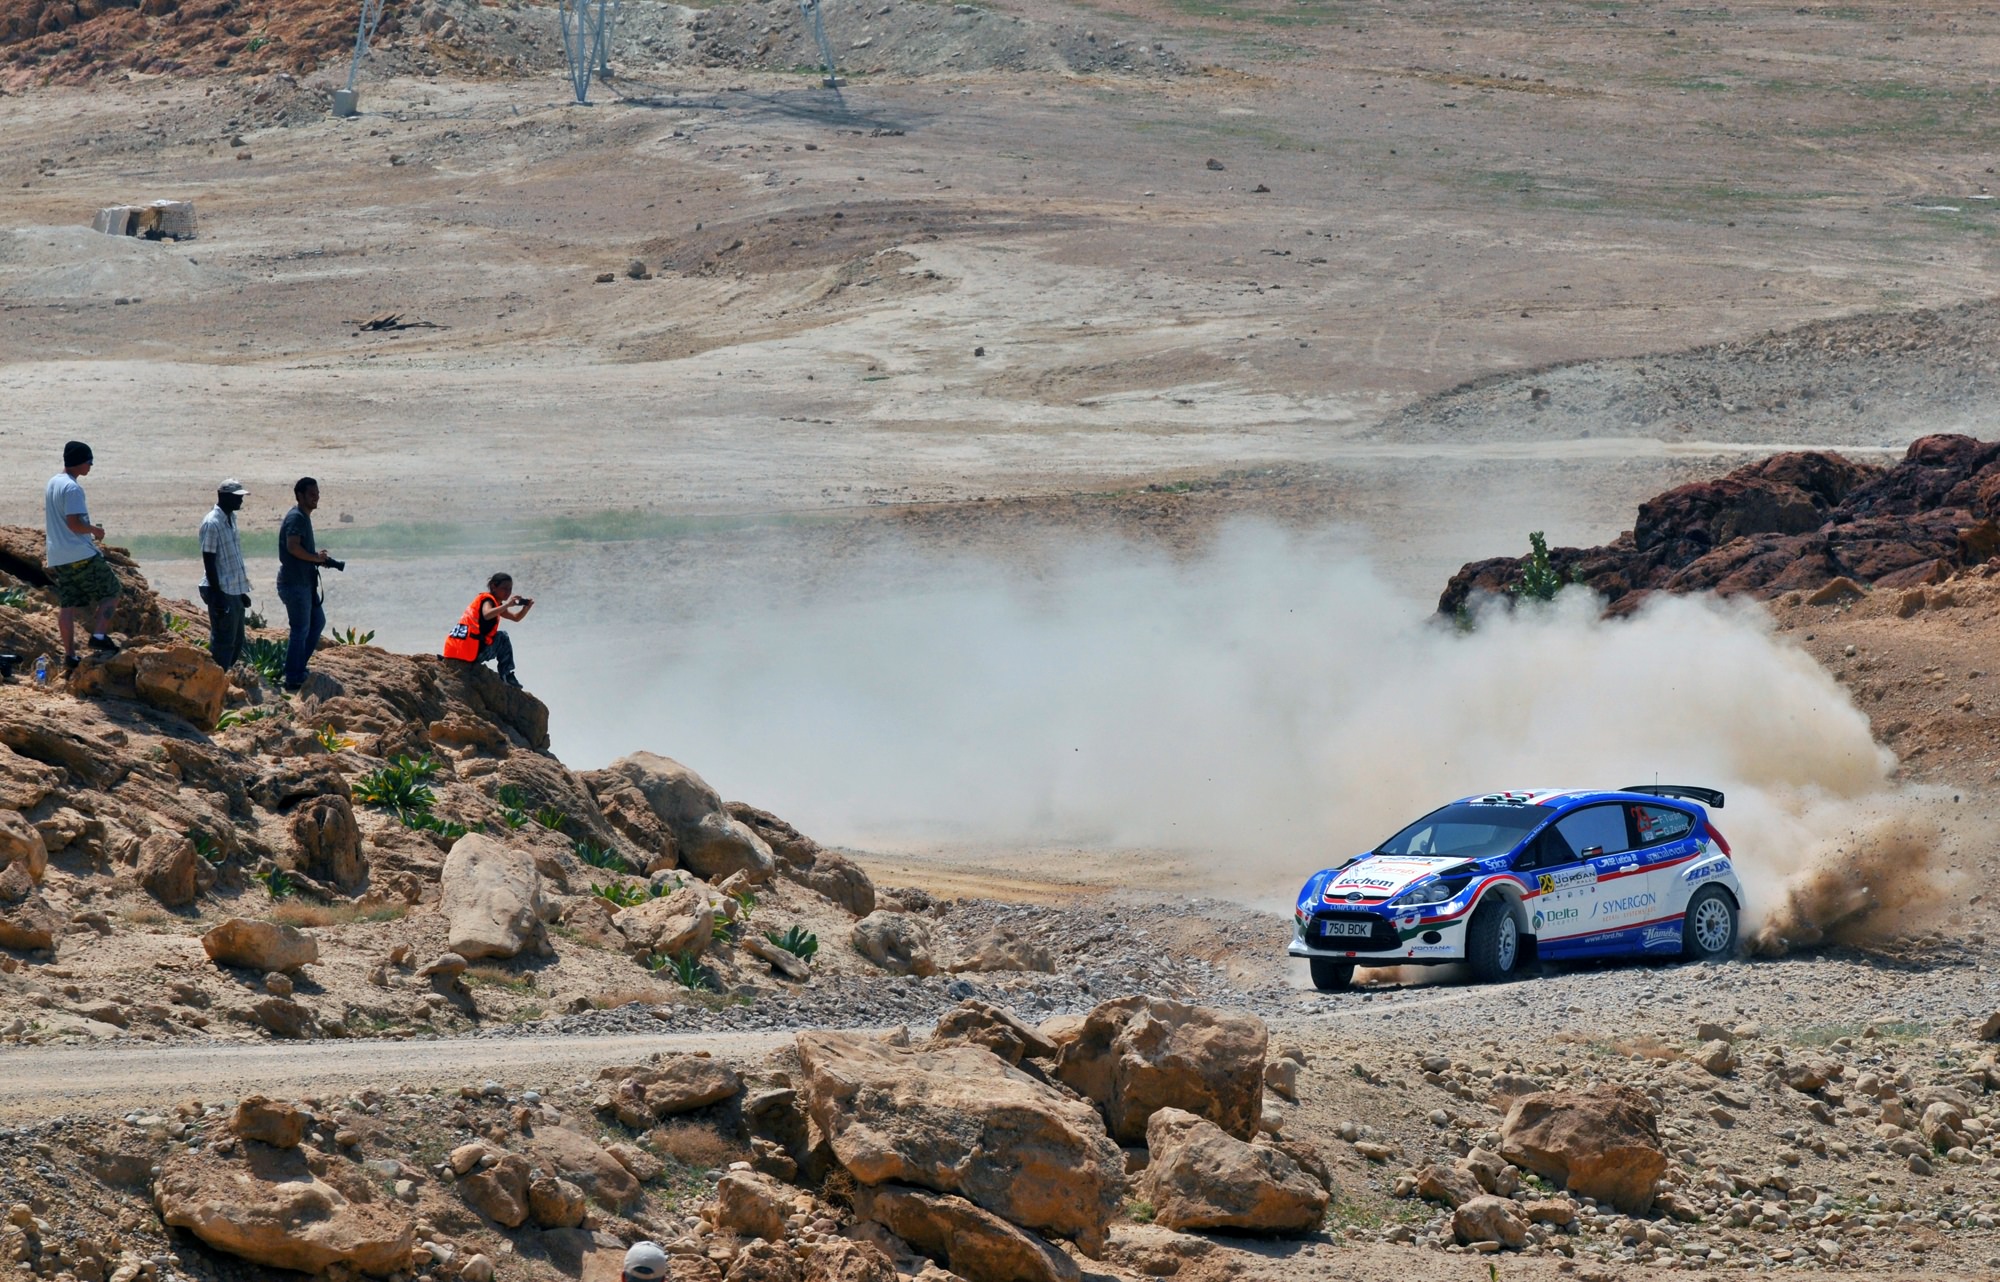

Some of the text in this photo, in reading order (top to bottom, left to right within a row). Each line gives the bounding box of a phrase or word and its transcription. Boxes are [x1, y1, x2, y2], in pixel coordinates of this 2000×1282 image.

[1485, 859, 1507, 872] Spice
[1686, 861, 1731, 881] HE-DO
[1339, 877, 1394, 888] techem
[1555, 871, 1596, 884] JORDAN
[1538, 874, 1555, 895] 29
[1602, 892, 1656, 915] SYNERGON
[1547, 908, 1578, 922] Delta
[1329, 922, 1344, 934] 750
[1348, 923, 1367, 935] BDK
[1585, 932, 1624, 944] www.ford.hu
